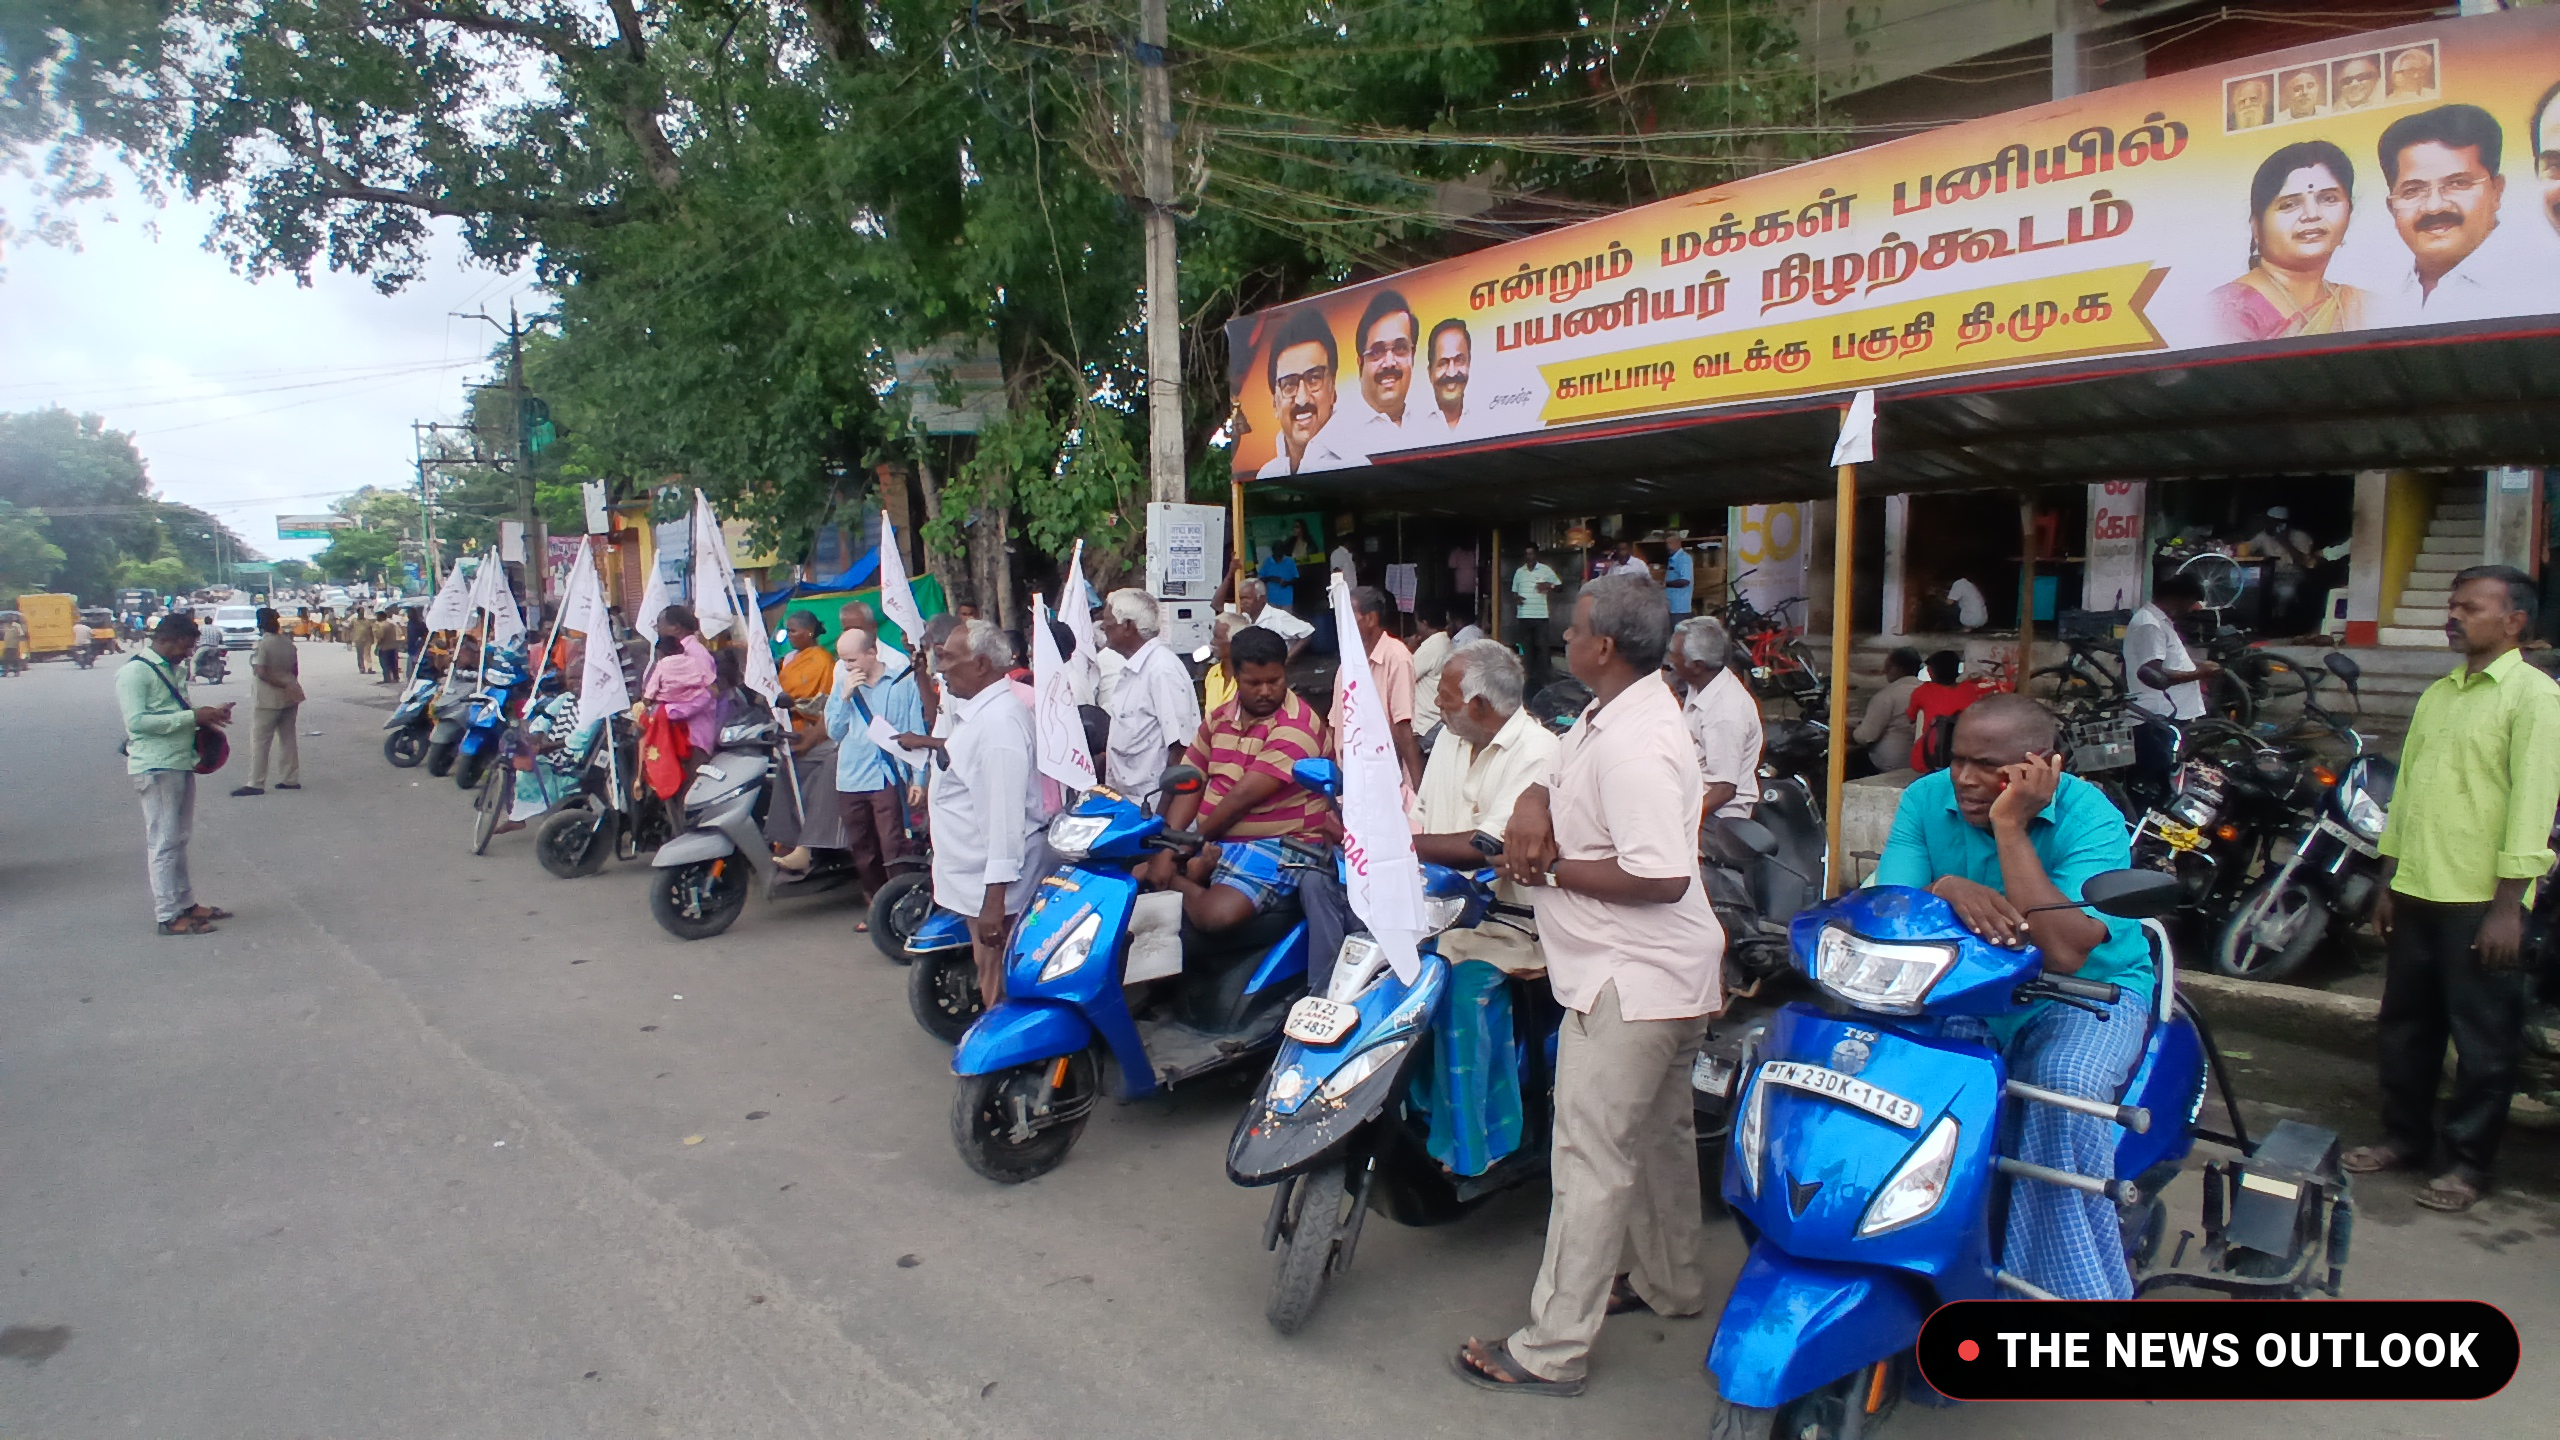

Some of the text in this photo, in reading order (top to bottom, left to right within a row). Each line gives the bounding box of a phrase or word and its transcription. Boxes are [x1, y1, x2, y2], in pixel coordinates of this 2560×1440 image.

[1470, 111, 2189, 310] என்றும் மக்கள் பனியில்
[1496, 189, 2133, 352] பயணியர் நிழற்கூடம்
[1556, 360, 1675, 400] காட்பாடி
[1693, 339, 1811, 378] வடக்கு
[1832, 311, 1935, 361] பகுதி
[1956, 292, 2113, 353] தி.மு.க
[1303, 1020, 1334, 1038] 4837
[1305, 1000, 1339, 1016] TN 23
[1843, 1026, 1877, 1042] TVS
